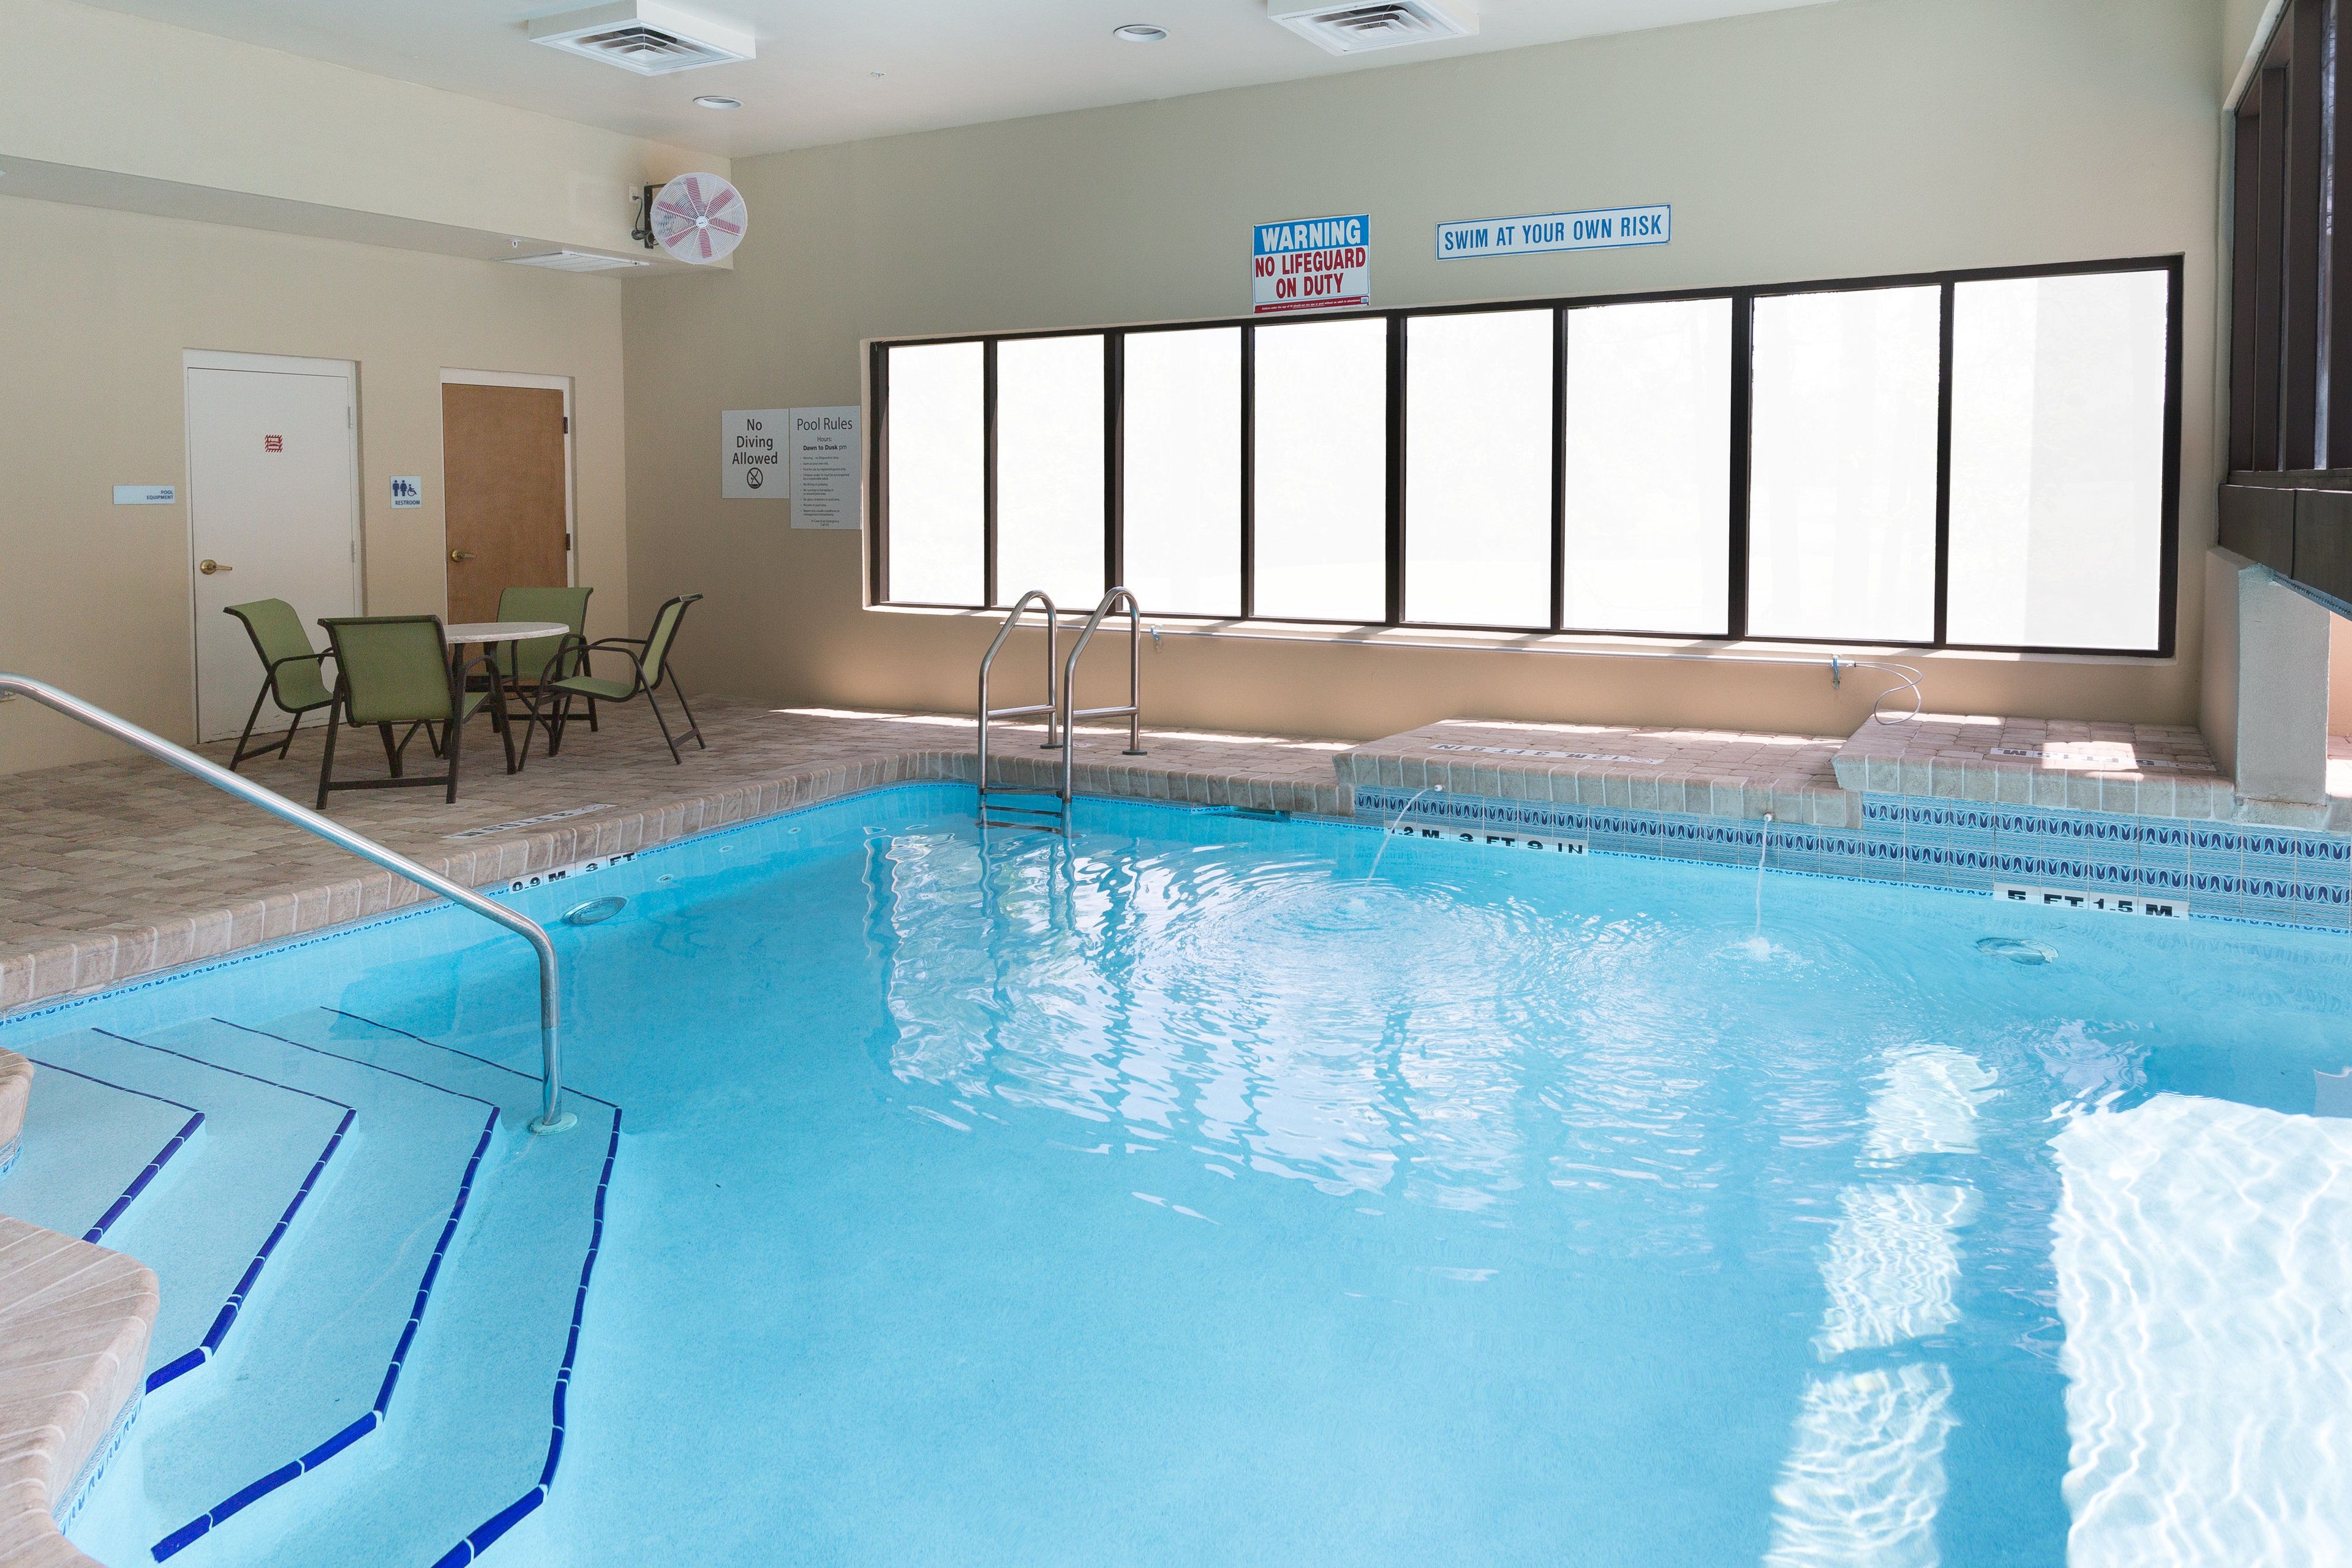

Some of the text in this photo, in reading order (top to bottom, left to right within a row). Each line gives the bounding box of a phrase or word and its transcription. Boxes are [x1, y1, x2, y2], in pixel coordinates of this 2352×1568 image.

[1262, 219, 1361, 252] WARNING
[1444, 214, 1662, 251] SWIM AT YOUR OWN RISK
[1256, 247, 1366, 277] NO LIFEGUARD
[1276, 273, 1344, 299] ON DUTY
[747, 419, 763, 431] No
[797, 417, 853, 431] Pool Rules
[736, 435, 773, 450] Diving
[732, 451, 778, 464] Allowed
[1422, 829, 1444, 839] M.
[1459, 833, 1474, 842] 3
[1487, 835, 1515, 847] FT.
[1527, 840, 1544, 850] 9
[1558, 843, 1583, 854] IN
[512, 852, 636, 892] 0.9 M. 3 FT.
[2008, 890, 2026, 900] 5
[2093, 898, 2133, 912] 1.5
[2146, 903, 2180, 918] M.
